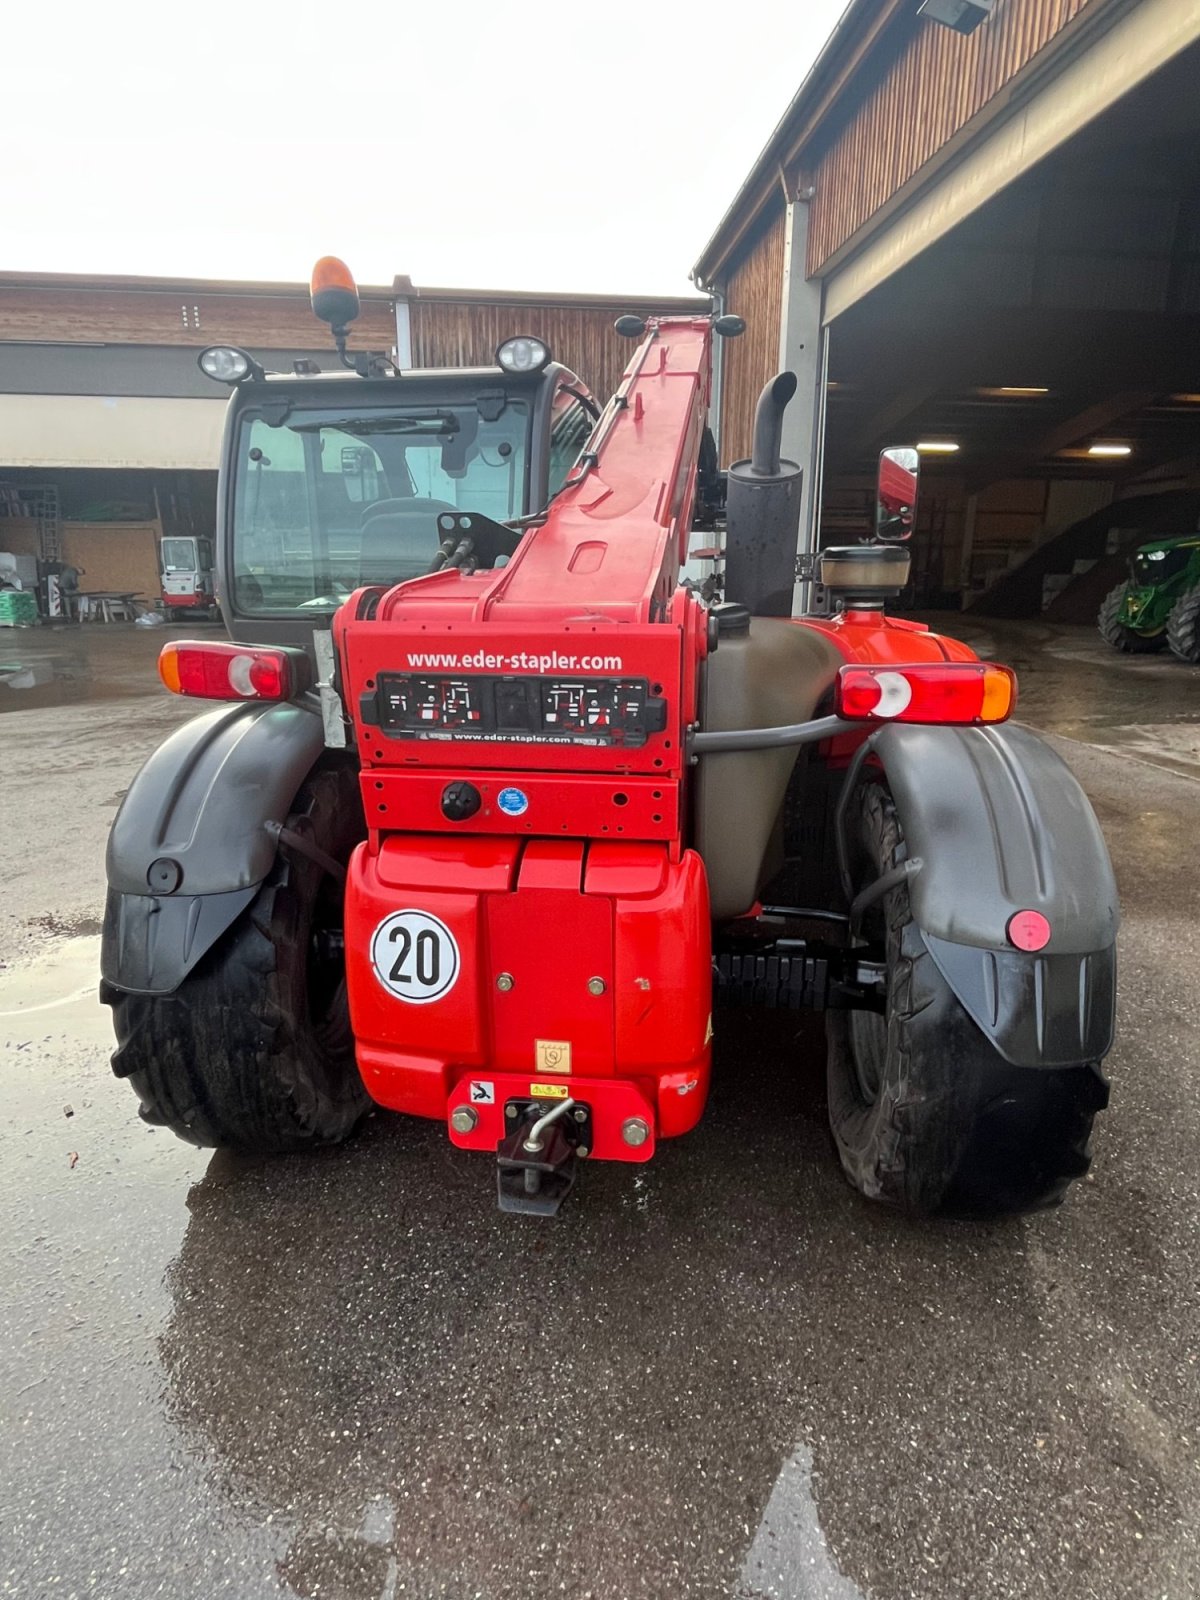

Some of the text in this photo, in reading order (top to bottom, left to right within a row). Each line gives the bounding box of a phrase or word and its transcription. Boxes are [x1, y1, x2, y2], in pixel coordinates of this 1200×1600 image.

[407, 650, 622, 673] www.eder-stapler.com
[454, 733, 571, 743] www.eder-stapler.com
[389, 926, 440, 986] 20
